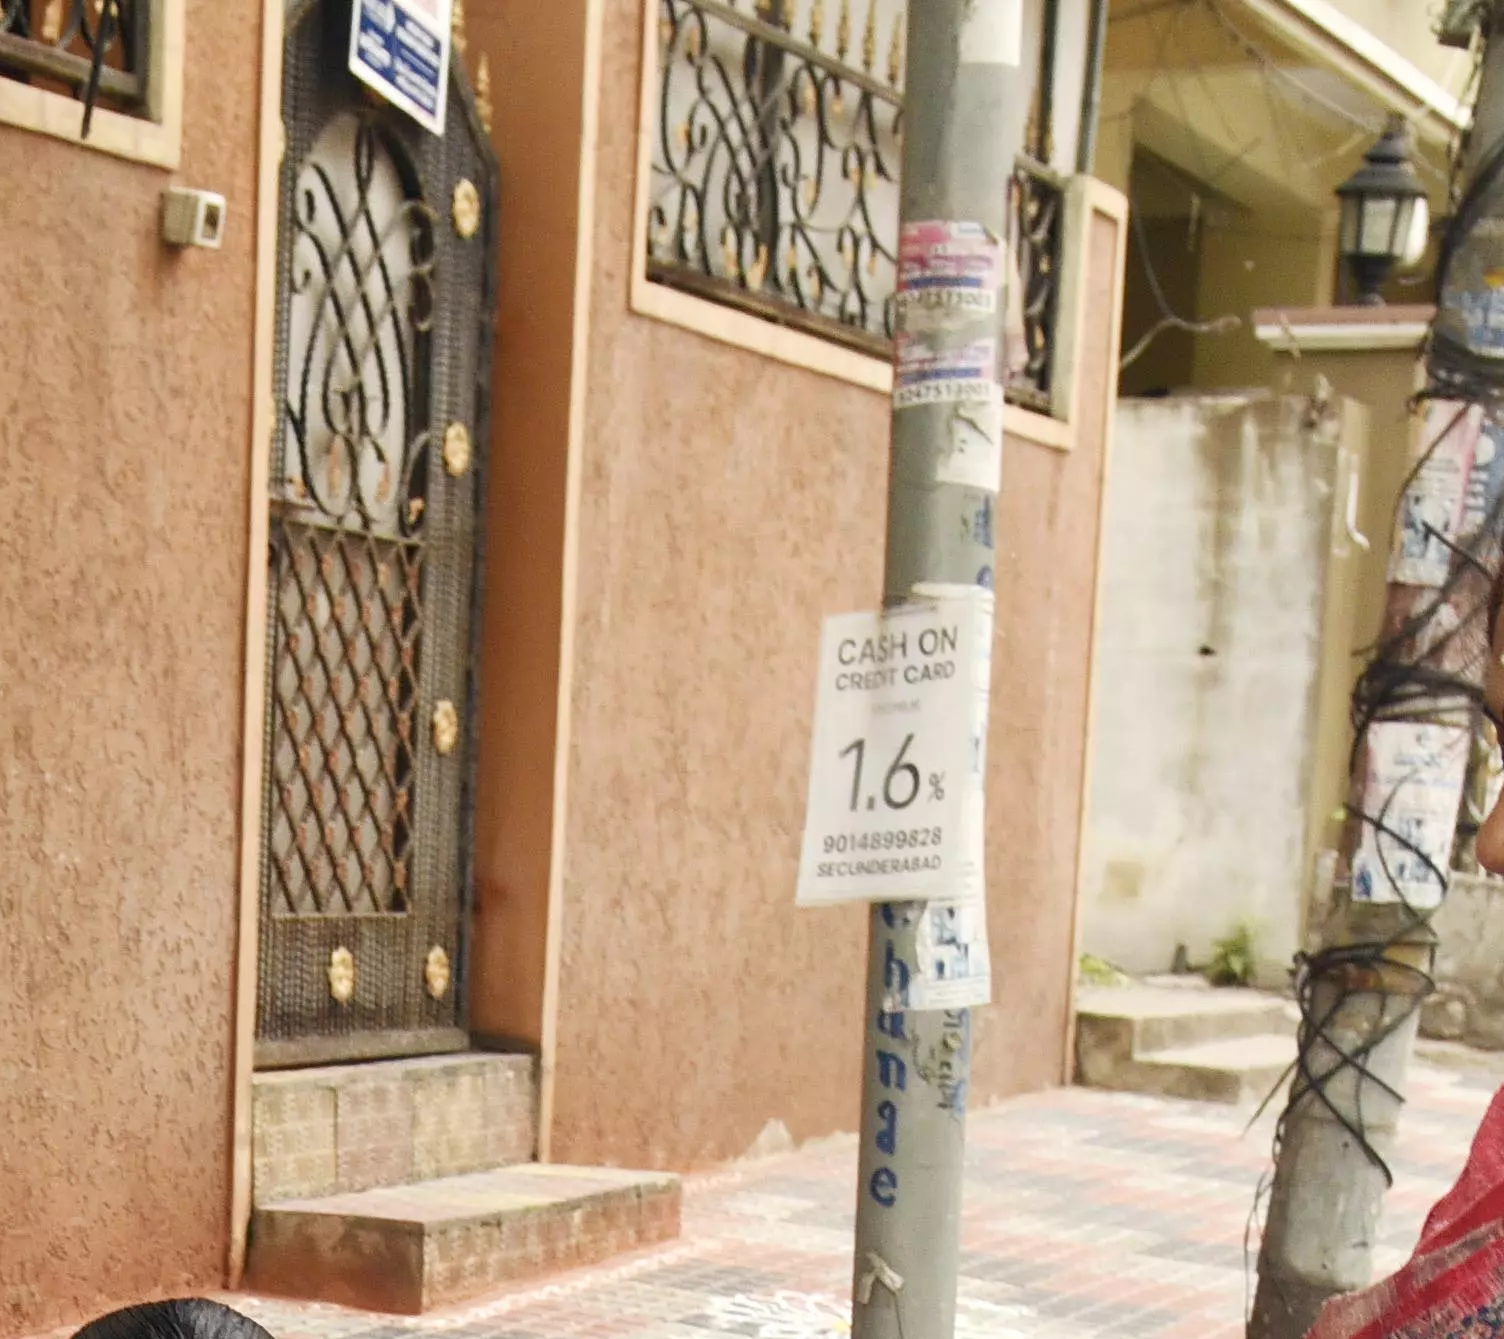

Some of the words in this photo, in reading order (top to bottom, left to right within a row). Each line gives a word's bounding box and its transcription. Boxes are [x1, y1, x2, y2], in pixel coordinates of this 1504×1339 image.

[837, 632, 907, 667] CASH
[918, 626, 958, 656] ON
[835, 668, 897, 691] CREDIT
[903, 660, 955, 684] CARD
[839, 733, 920, 812] 1.6
[816, 854, 942, 877] SECUNDERABAD
